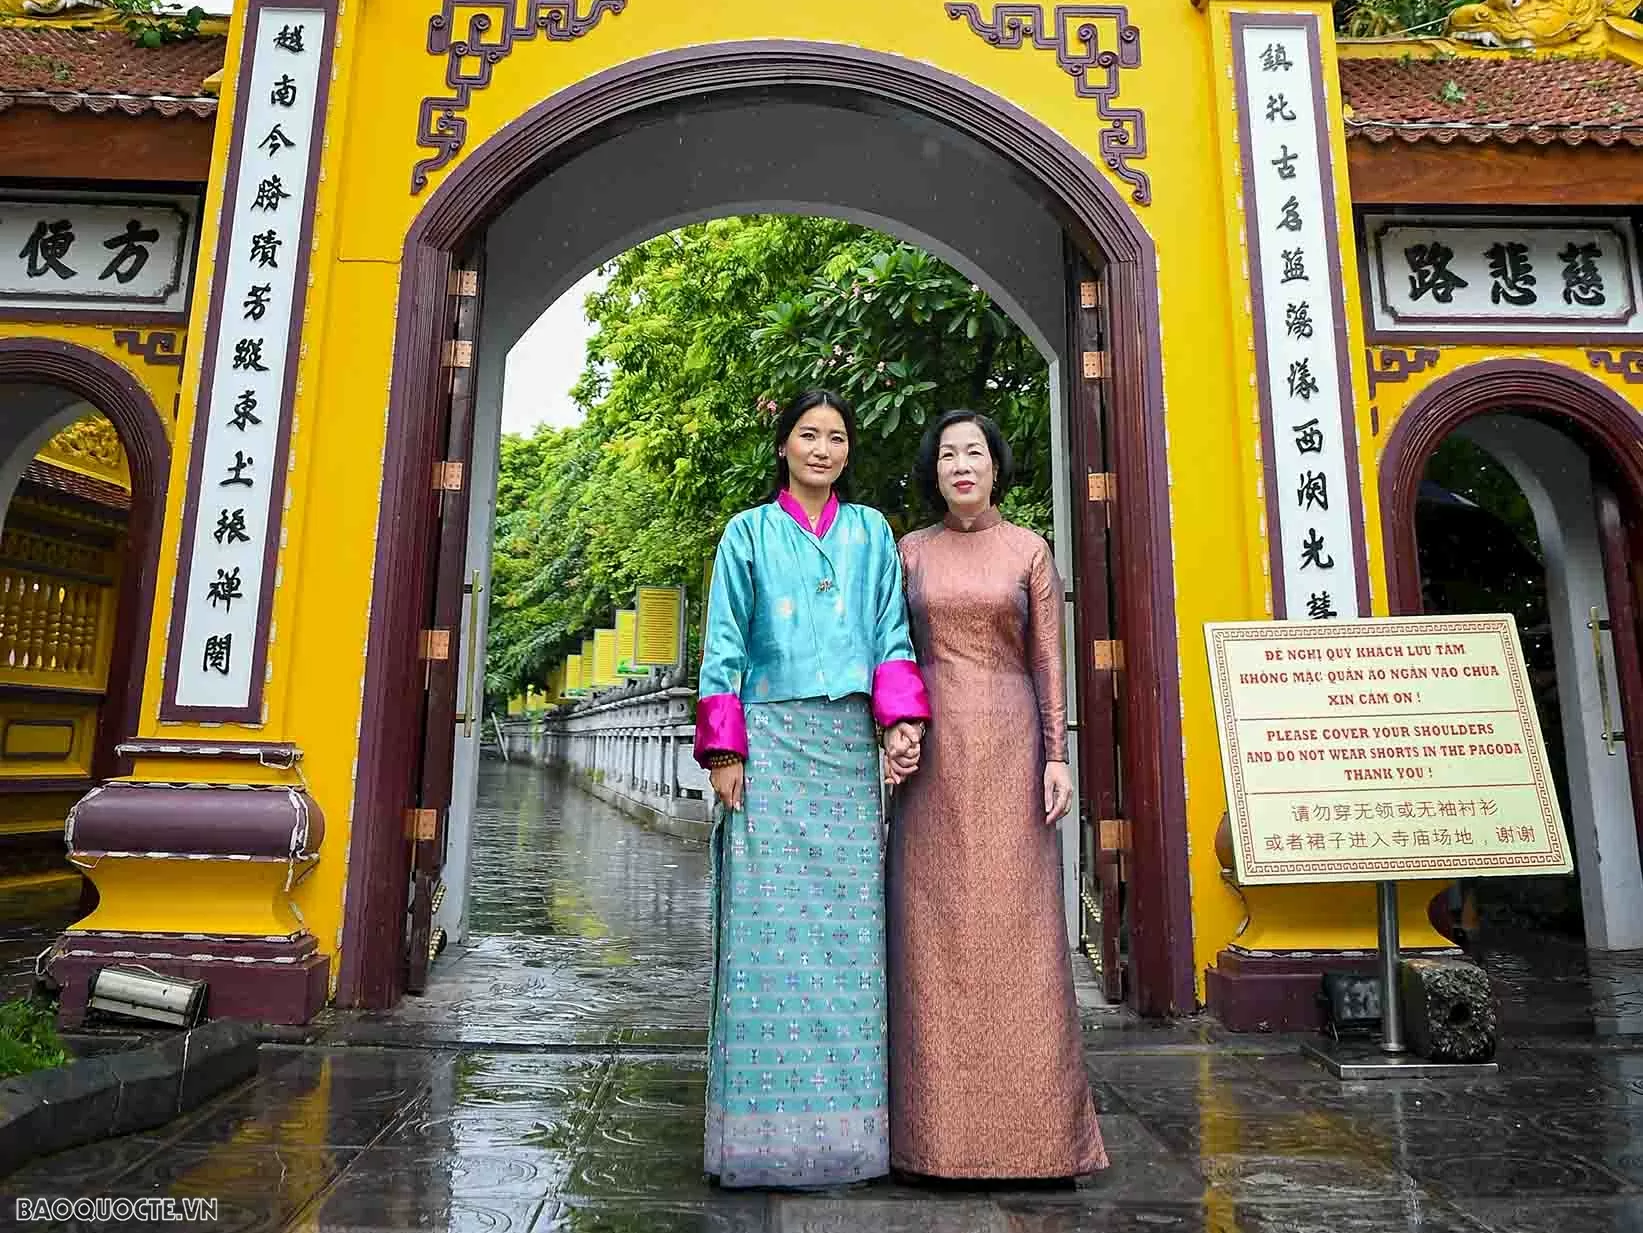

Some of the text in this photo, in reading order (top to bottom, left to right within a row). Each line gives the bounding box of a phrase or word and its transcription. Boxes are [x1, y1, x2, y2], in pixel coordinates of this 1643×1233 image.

[1328, 694, 1354, 706] XIN
[1266, 723, 1494, 742] PLEASE COVER YOUR SHOULDERS
[1247, 742, 1523, 763] AND DO NOT WEAR SHORTS IN THE PAGODA
[1344, 768, 1393, 781] THANK
[1396, 767, 1424, 779] YOU
[1291, 798, 1498, 823] 请勿穿无领或无袖衬衫
